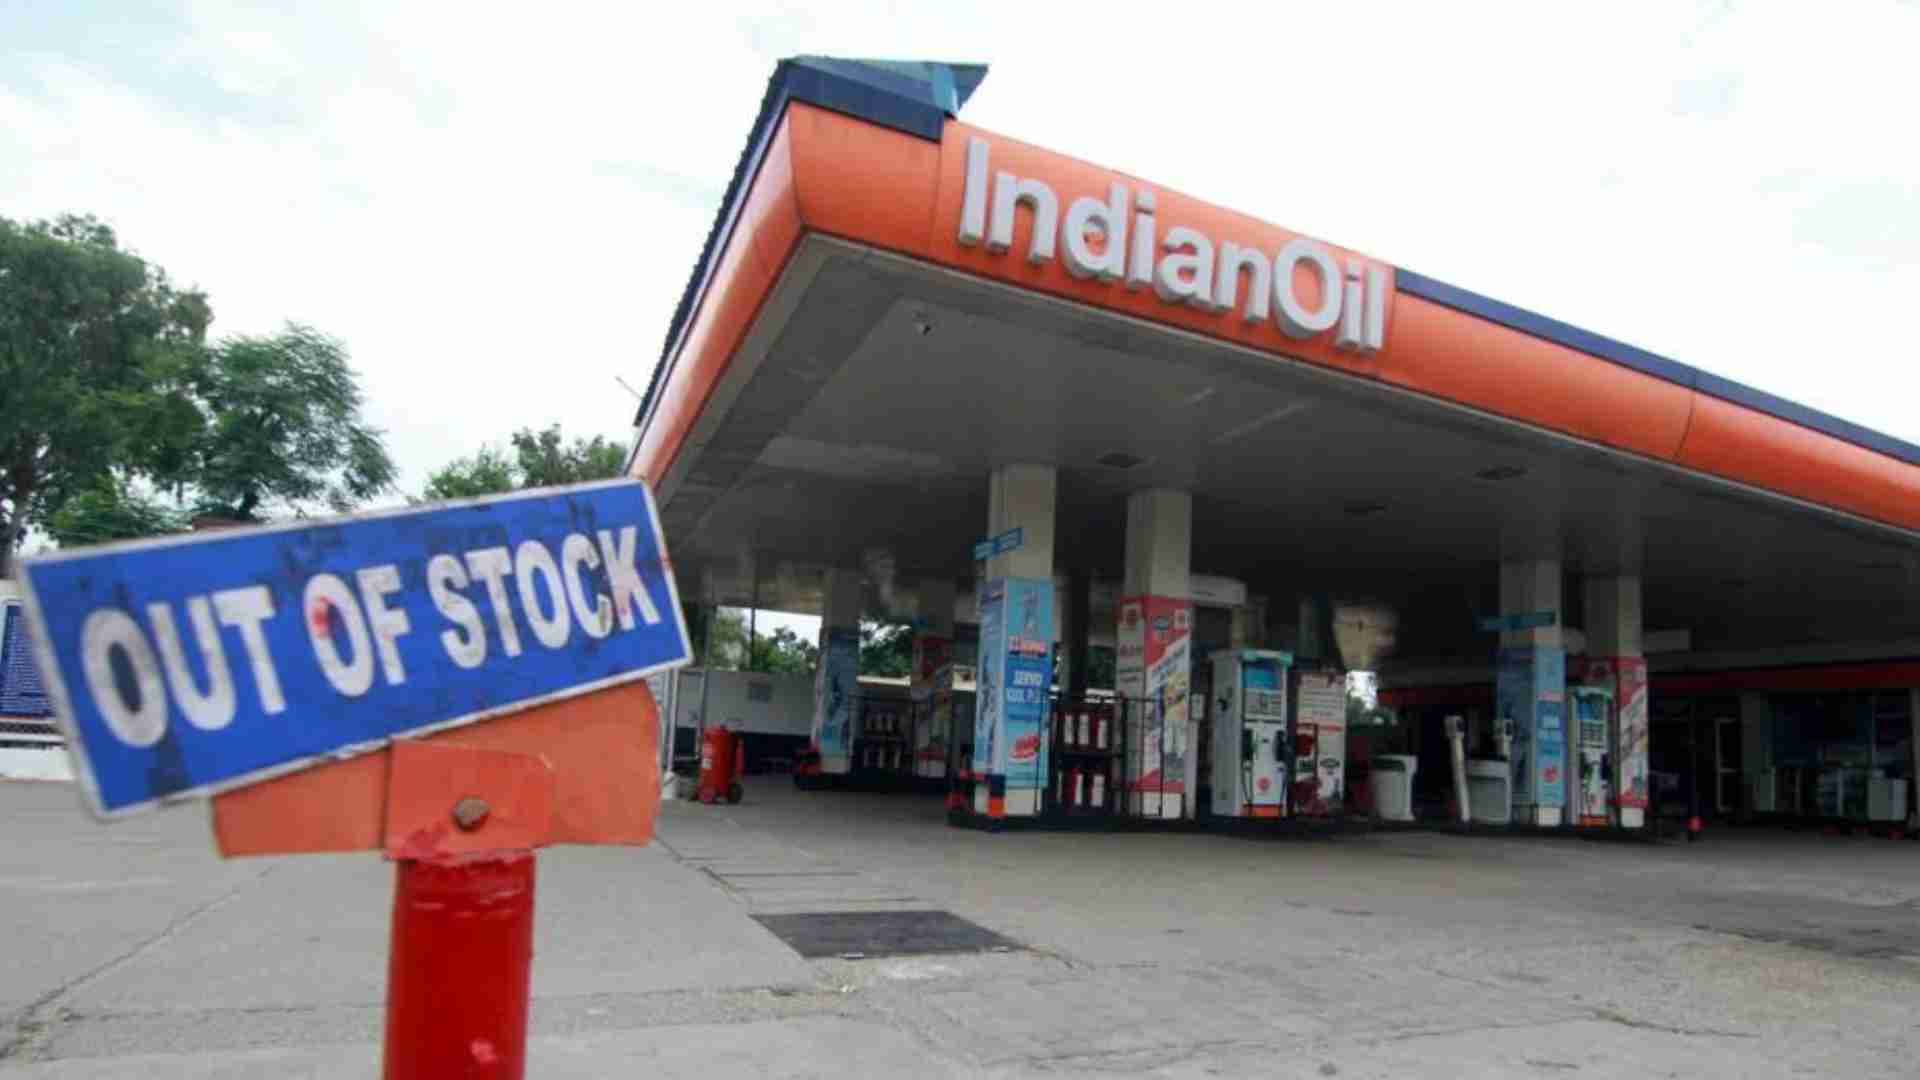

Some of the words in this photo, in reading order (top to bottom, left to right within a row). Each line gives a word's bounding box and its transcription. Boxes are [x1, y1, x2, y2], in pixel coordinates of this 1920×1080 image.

[959, 137, 1386, 352] IndianOil
[81, 586, 286, 747] OUT
[304, 565, 409, 697] OF
[426, 526, 659, 668] STOCK
